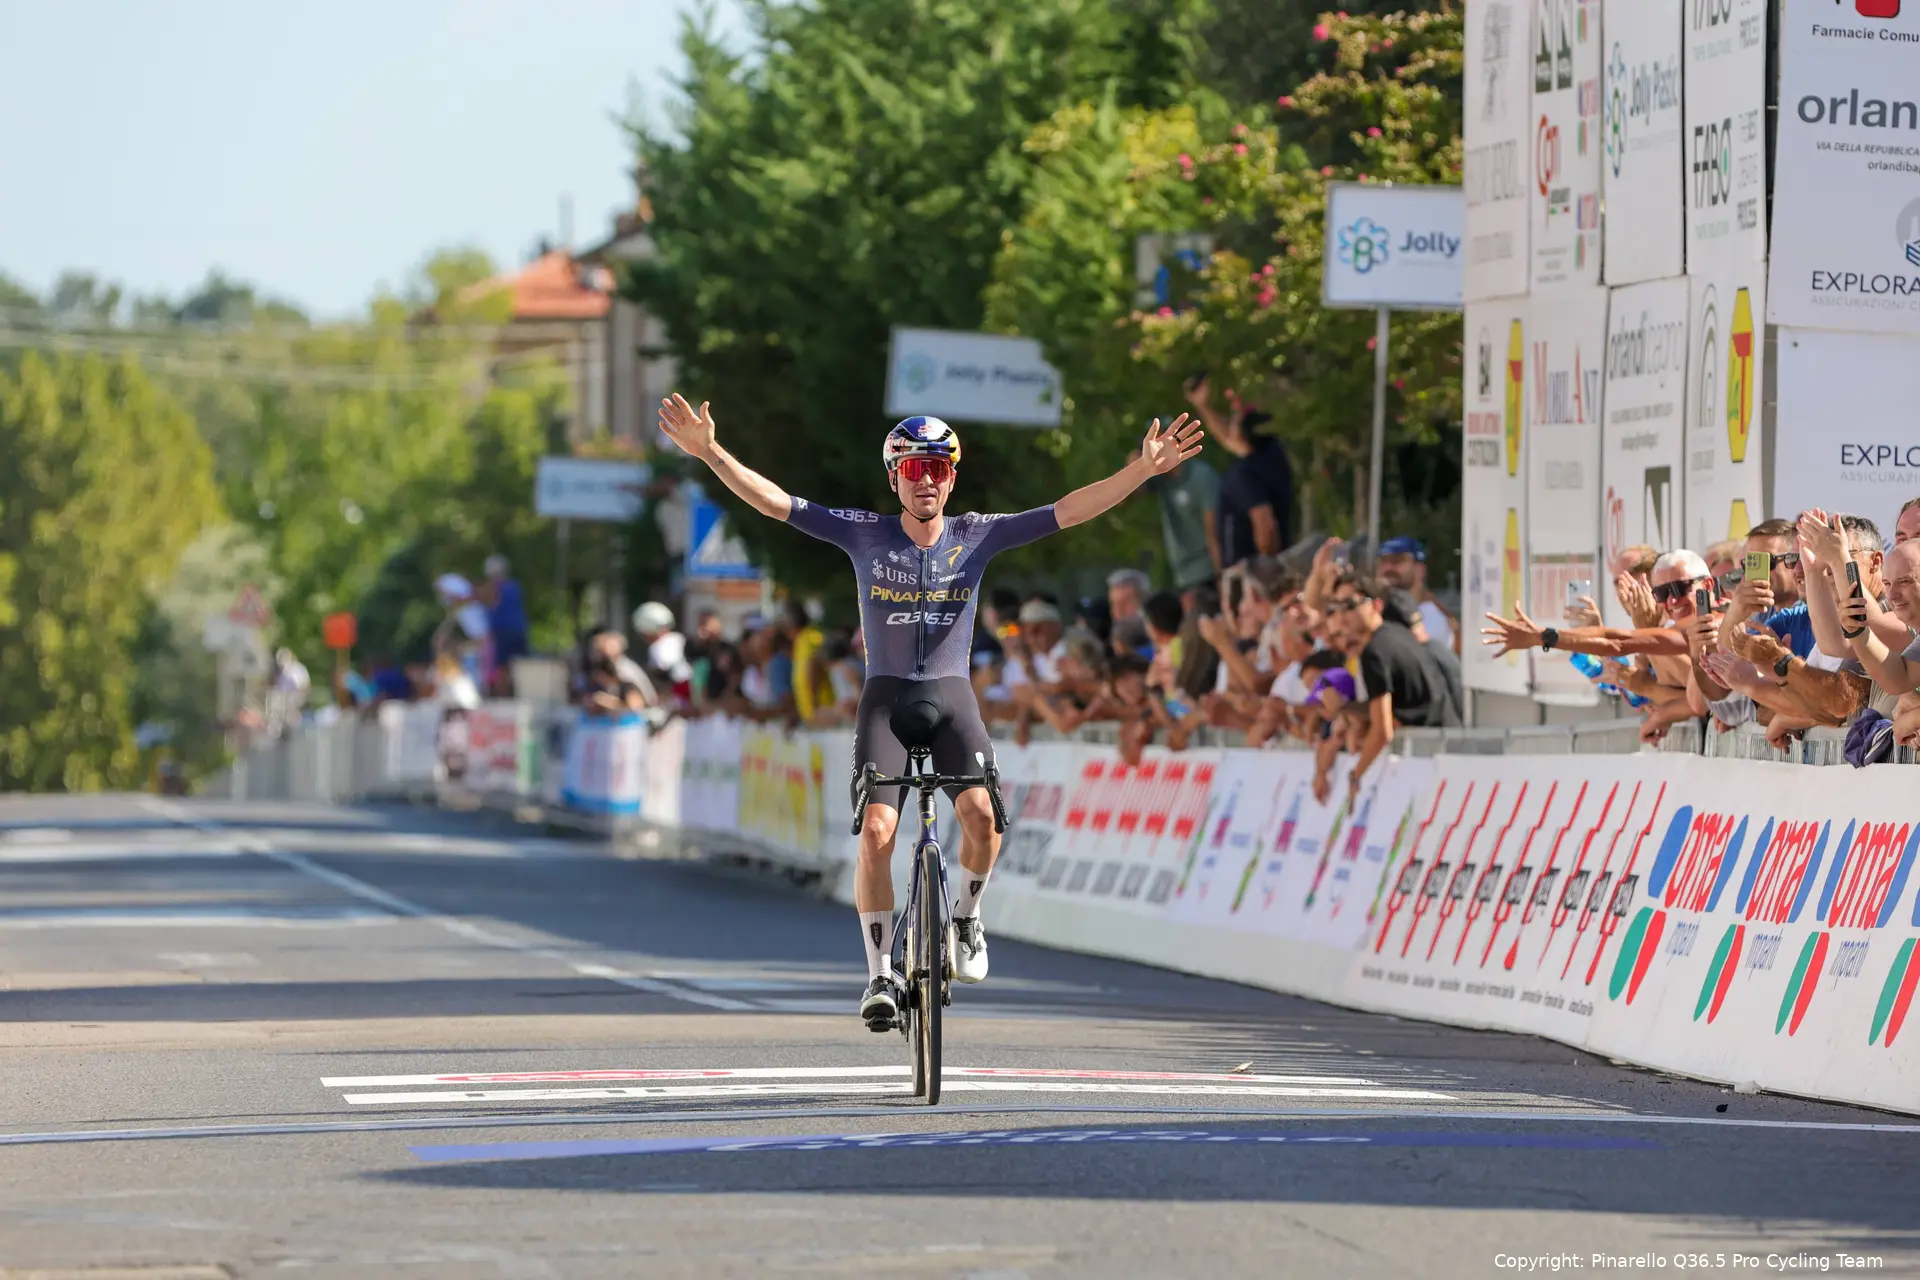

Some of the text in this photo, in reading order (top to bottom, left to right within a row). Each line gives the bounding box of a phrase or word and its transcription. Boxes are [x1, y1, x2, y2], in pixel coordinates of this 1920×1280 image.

[1811, 24, 1875, 40] Farmacie
[1798, 88, 1918, 130] orlan
[1816, 141, 1920, 157] VIA DELLA REPUBBLICA
[1693, 117, 1732, 210] FABO
[1867, 160, 1920, 176] orlandiba
[1399, 231, 1461, 259] Jolly
[1812, 270, 1920, 296] EXPLORA
[1841, 444, 1920, 468] EXPLO
[1841, 471, 1920, 484] ASSICURAZI
[829, 508, 880, 523] Q36.5
[885, 566, 918, 585] UBS
[939, 571, 966, 583] SRAM
[886, 611, 957, 626] Q36.5
